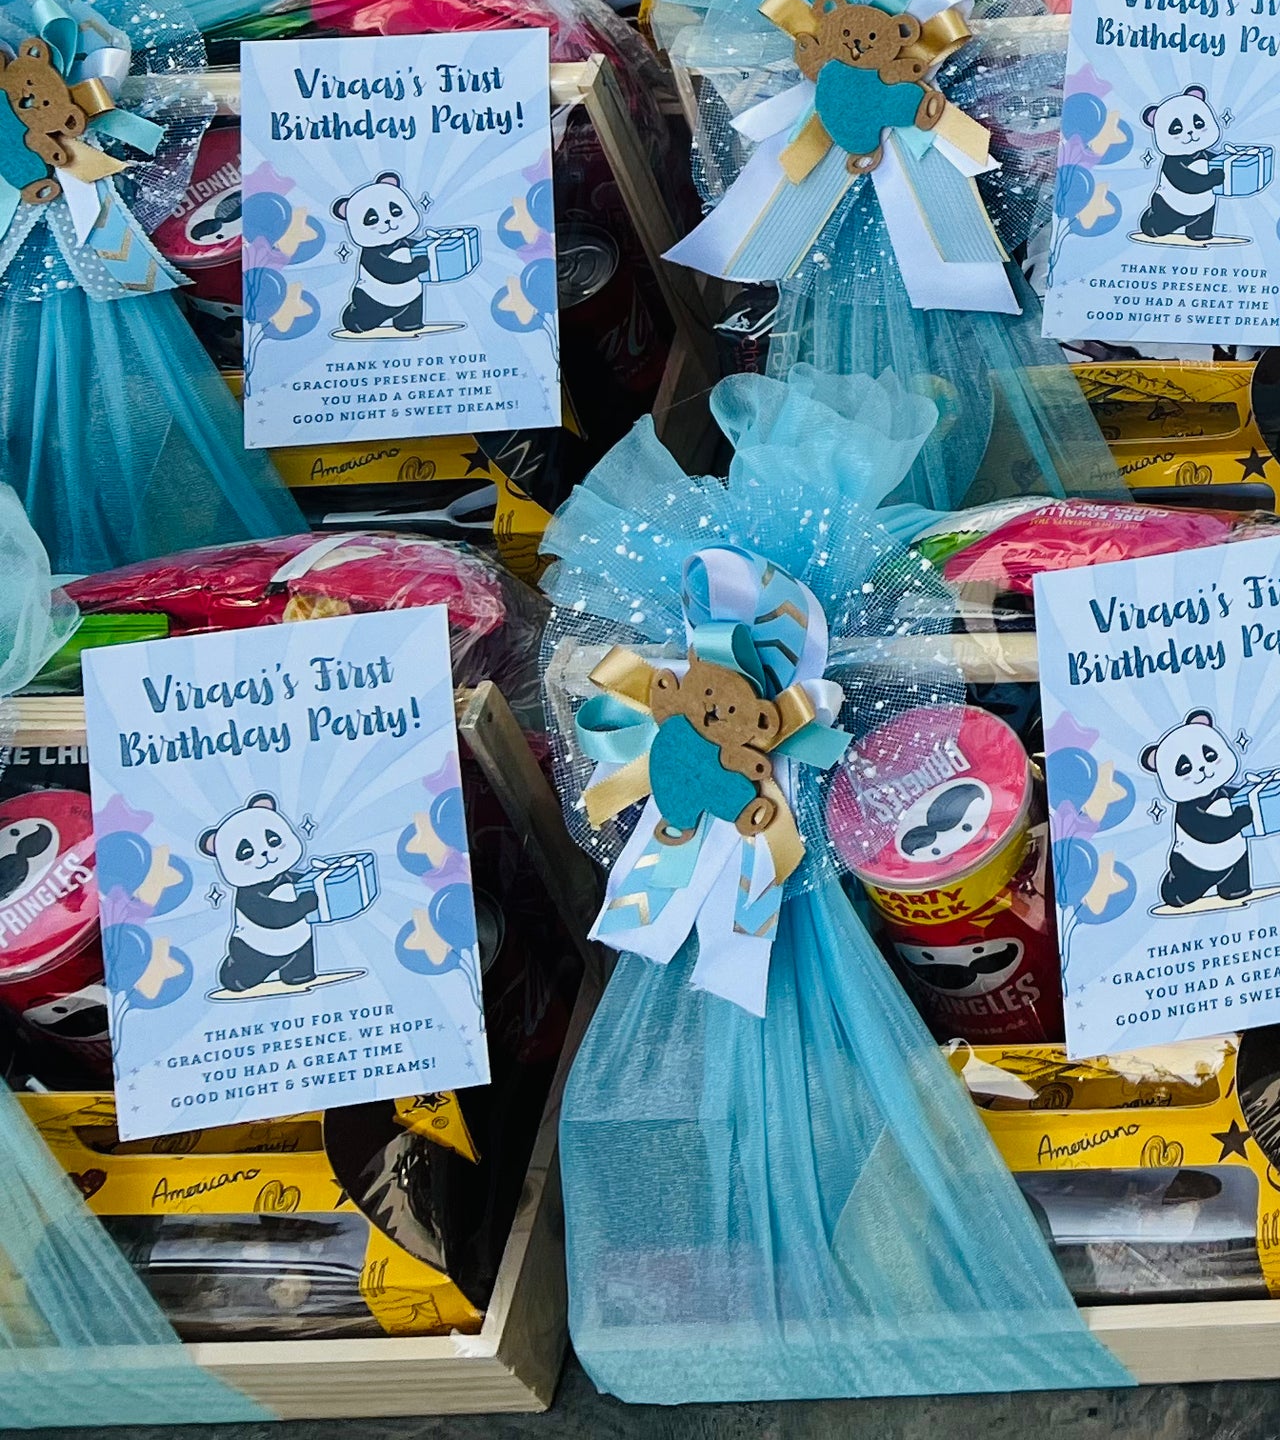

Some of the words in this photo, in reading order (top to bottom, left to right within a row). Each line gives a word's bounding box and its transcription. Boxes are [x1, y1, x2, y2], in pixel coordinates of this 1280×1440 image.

[295, 66, 425, 100] Viraaj's
[435, 64, 506, 93] First
[274, 108, 414, 142] Birthday
[430, 103, 525, 134] Party!
[310, 448, 400, 480] Americano
[1089, 582, 1232, 634] Viraaj's
[1070, 637, 1224, 687] Birthday
[142, 663, 298, 712] Viraaj's
[310, 657, 395, 691] First
[120, 718, 290, 768] Birthday
[306, 697, 421, 742] Party!
[1147, 939, 1203, 959] THANK
[1209, 932, 1241, 947] YOU
[1248, 925, 1279, 941] FOR
[1114, 960, 1196, 985] GRACIOUS
[1145, 984, 1178, 1001] YOU
[1184, 977, 1218, 994] HAD
[1224, 974, 1234, 987] A
[1116, 1008, 1161, 1027] GOOD
[1167, 998, 1217, 1017] NIGHT
[1038, 1124, 1141, 1165] Americano
[151, 1168, 261, 1208] Americano
